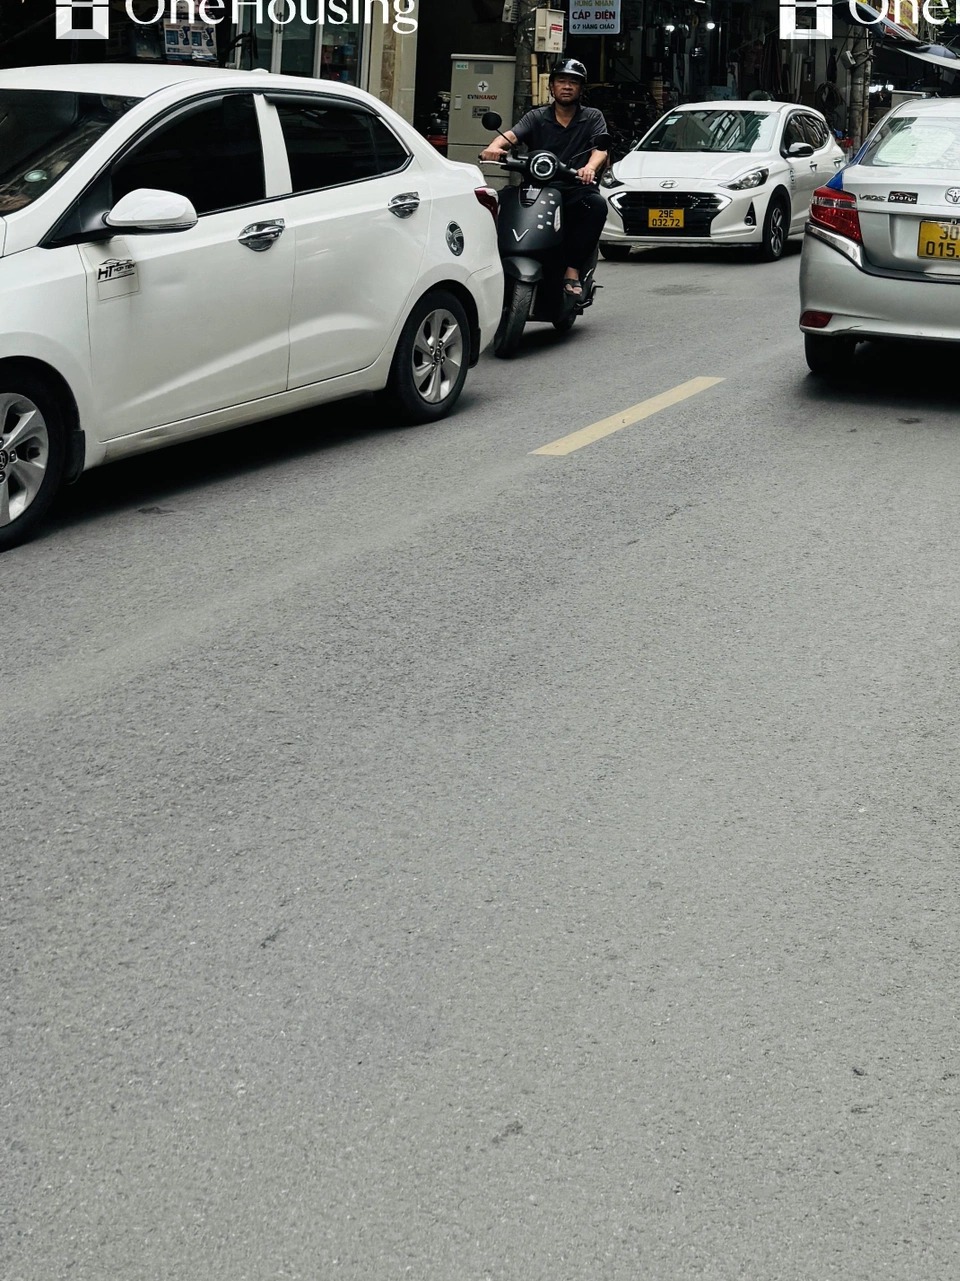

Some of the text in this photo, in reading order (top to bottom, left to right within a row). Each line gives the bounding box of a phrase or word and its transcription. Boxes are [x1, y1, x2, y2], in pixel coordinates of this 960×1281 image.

[572, 9, 616, 22] CÁP ĐIỆN
[658, 209, 674, 218] 29E
